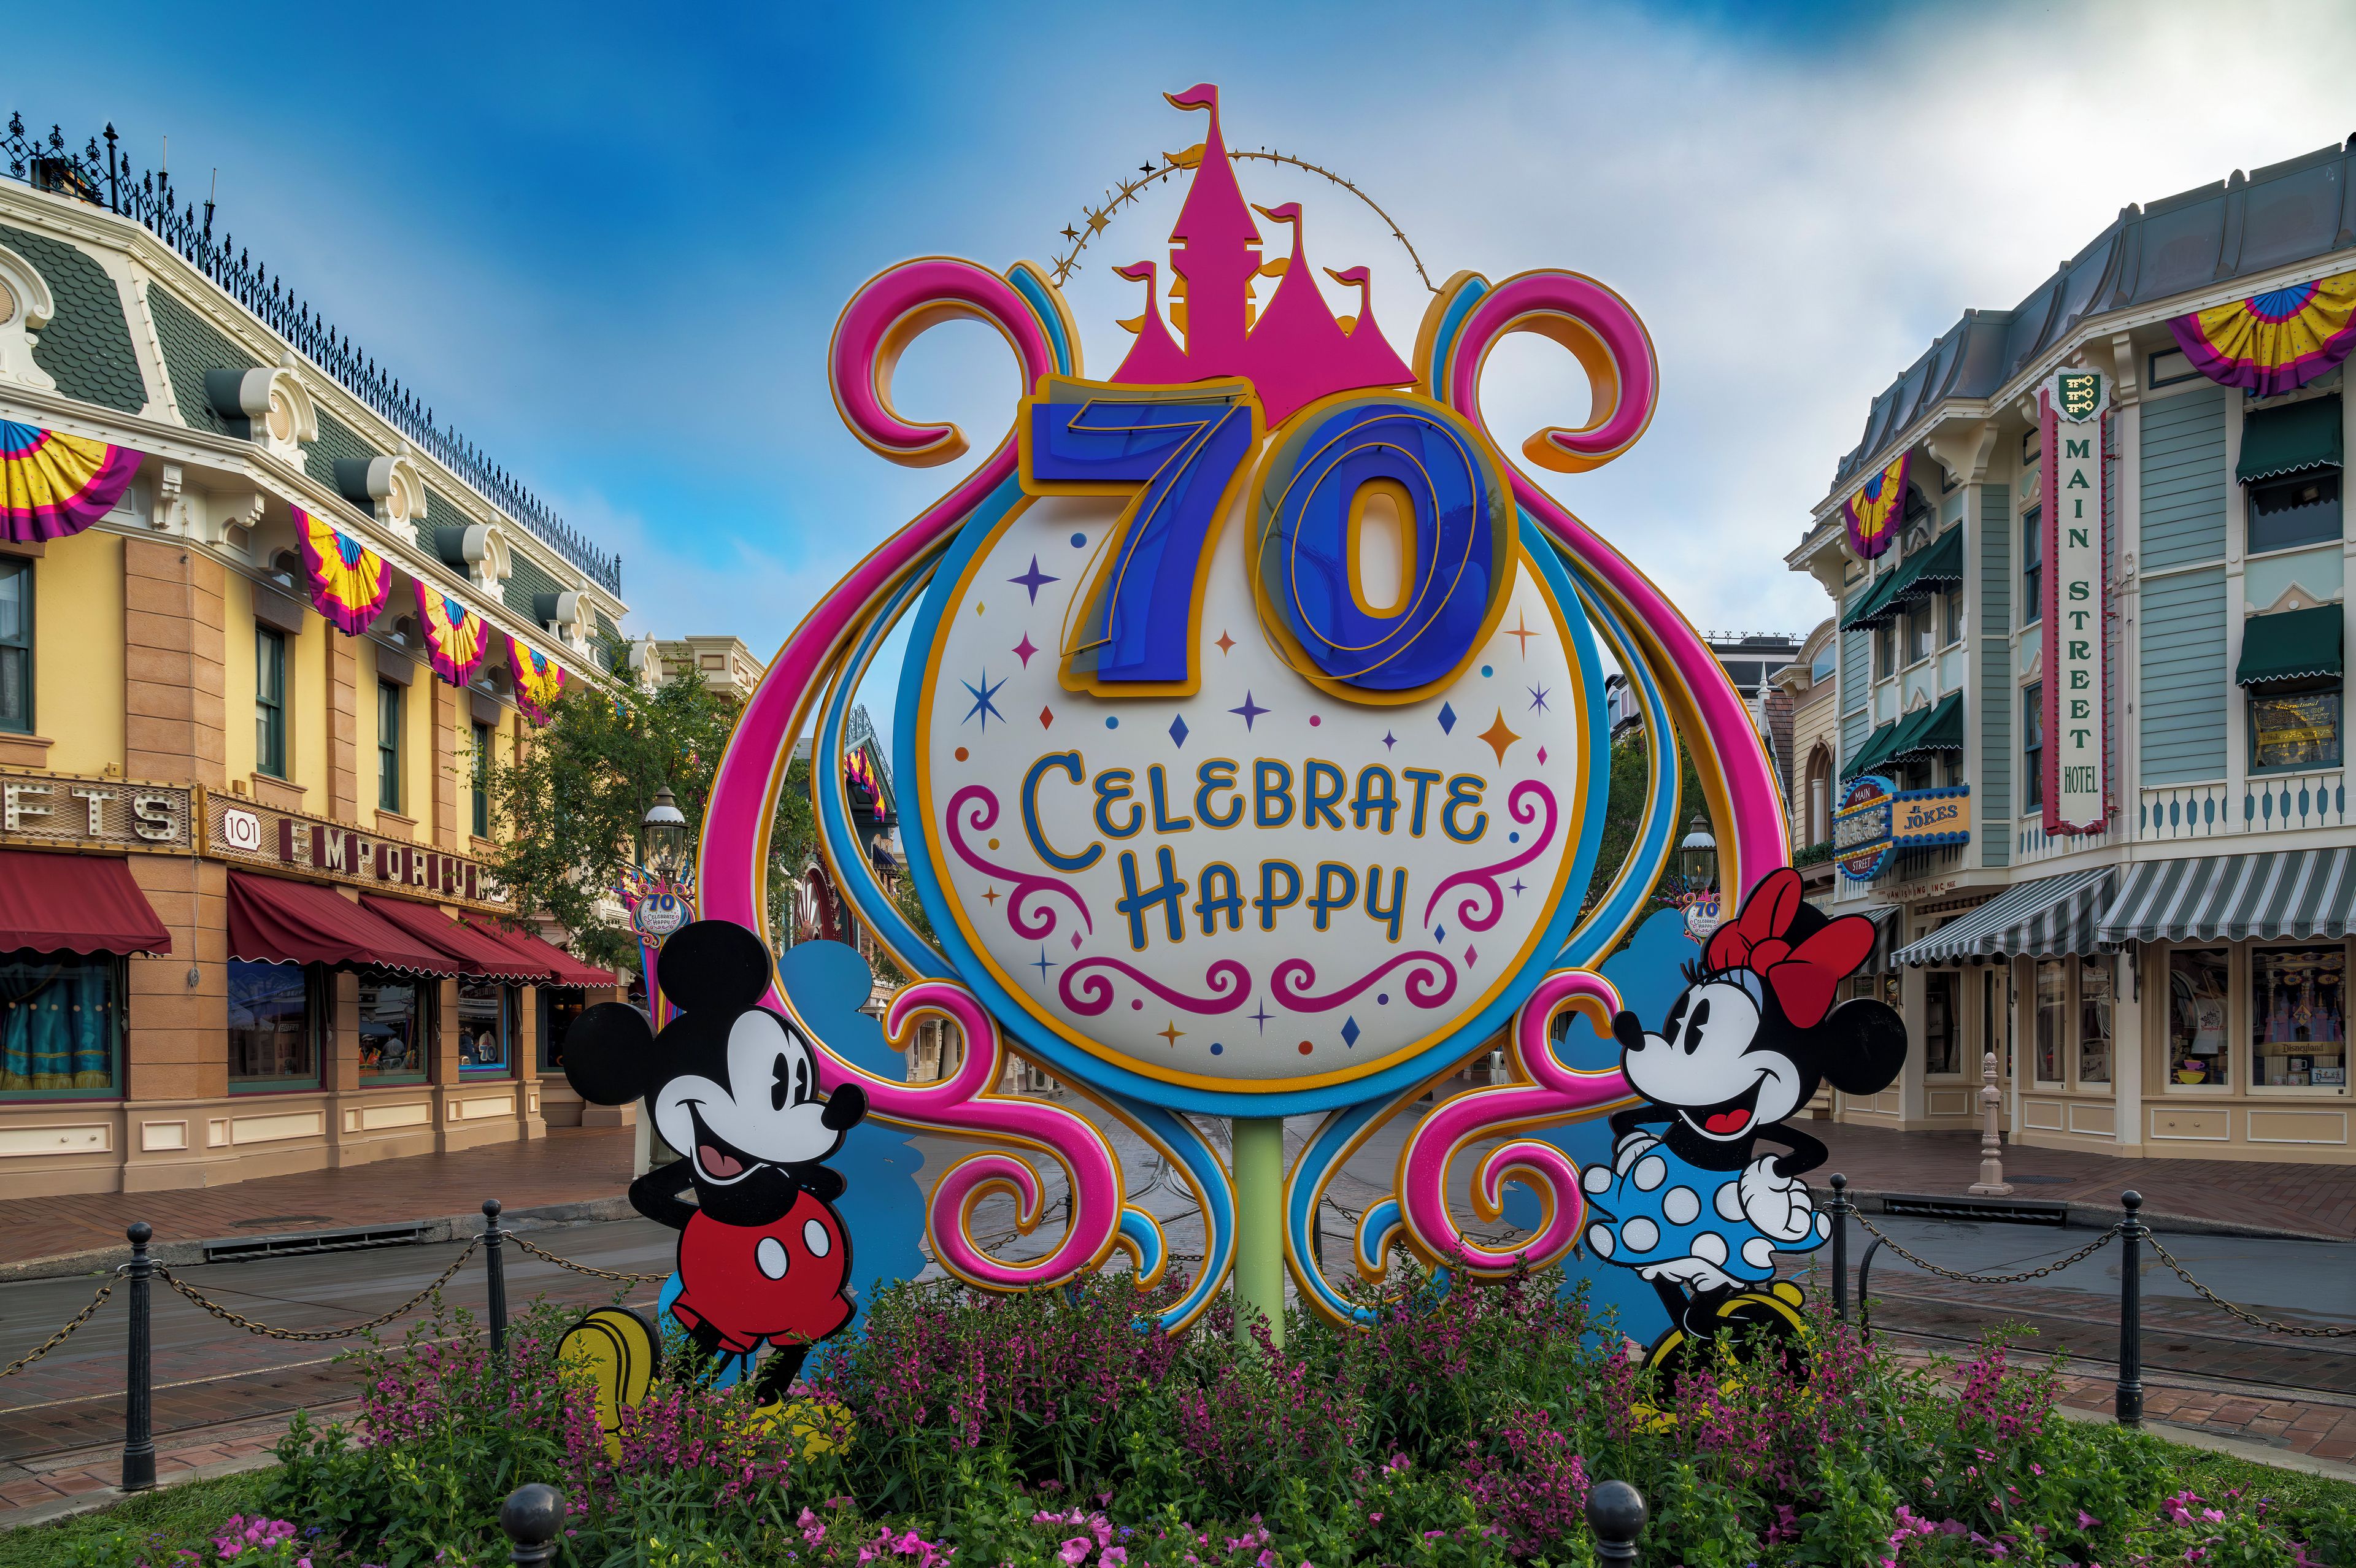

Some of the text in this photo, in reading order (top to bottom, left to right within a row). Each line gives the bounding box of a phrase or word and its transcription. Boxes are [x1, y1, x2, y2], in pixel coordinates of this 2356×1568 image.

[1018, 373, 1519, 706] 70
[2066, 439, 2091, 748] MAIN STREET
[2268, 709, 2308, 719] SCHOOL
[2276, 701, 2319, 710] International
[2264, 712, 2330, 725] HOSPITALITY
[2064, 766, 2098, 793] HOTEL
[1855, 788, 1871, 802] MAIN
[2, 780, 180, 840] FTS
[1020, 749, 1489, 874] CELEBRATE
[1904, 804, 1958, 830] JOKES
[228, 817, 256, 845] 101
[279, 818, 491, 902] EMPORIUM
[1852, 857, 1871, 871] STREET
[1115, 845, 1409, 952] HAPPY
[1887, 886, 1925, 900] VANISHING
[1931, 883, 1945, 892] INC.
[647, 893, 676, 912] 70
[1695, 901, 1718, 917] 70
[479, 1045, 496, 1061] 70
[2282, 1043, 2324, 1053] Disneyland
